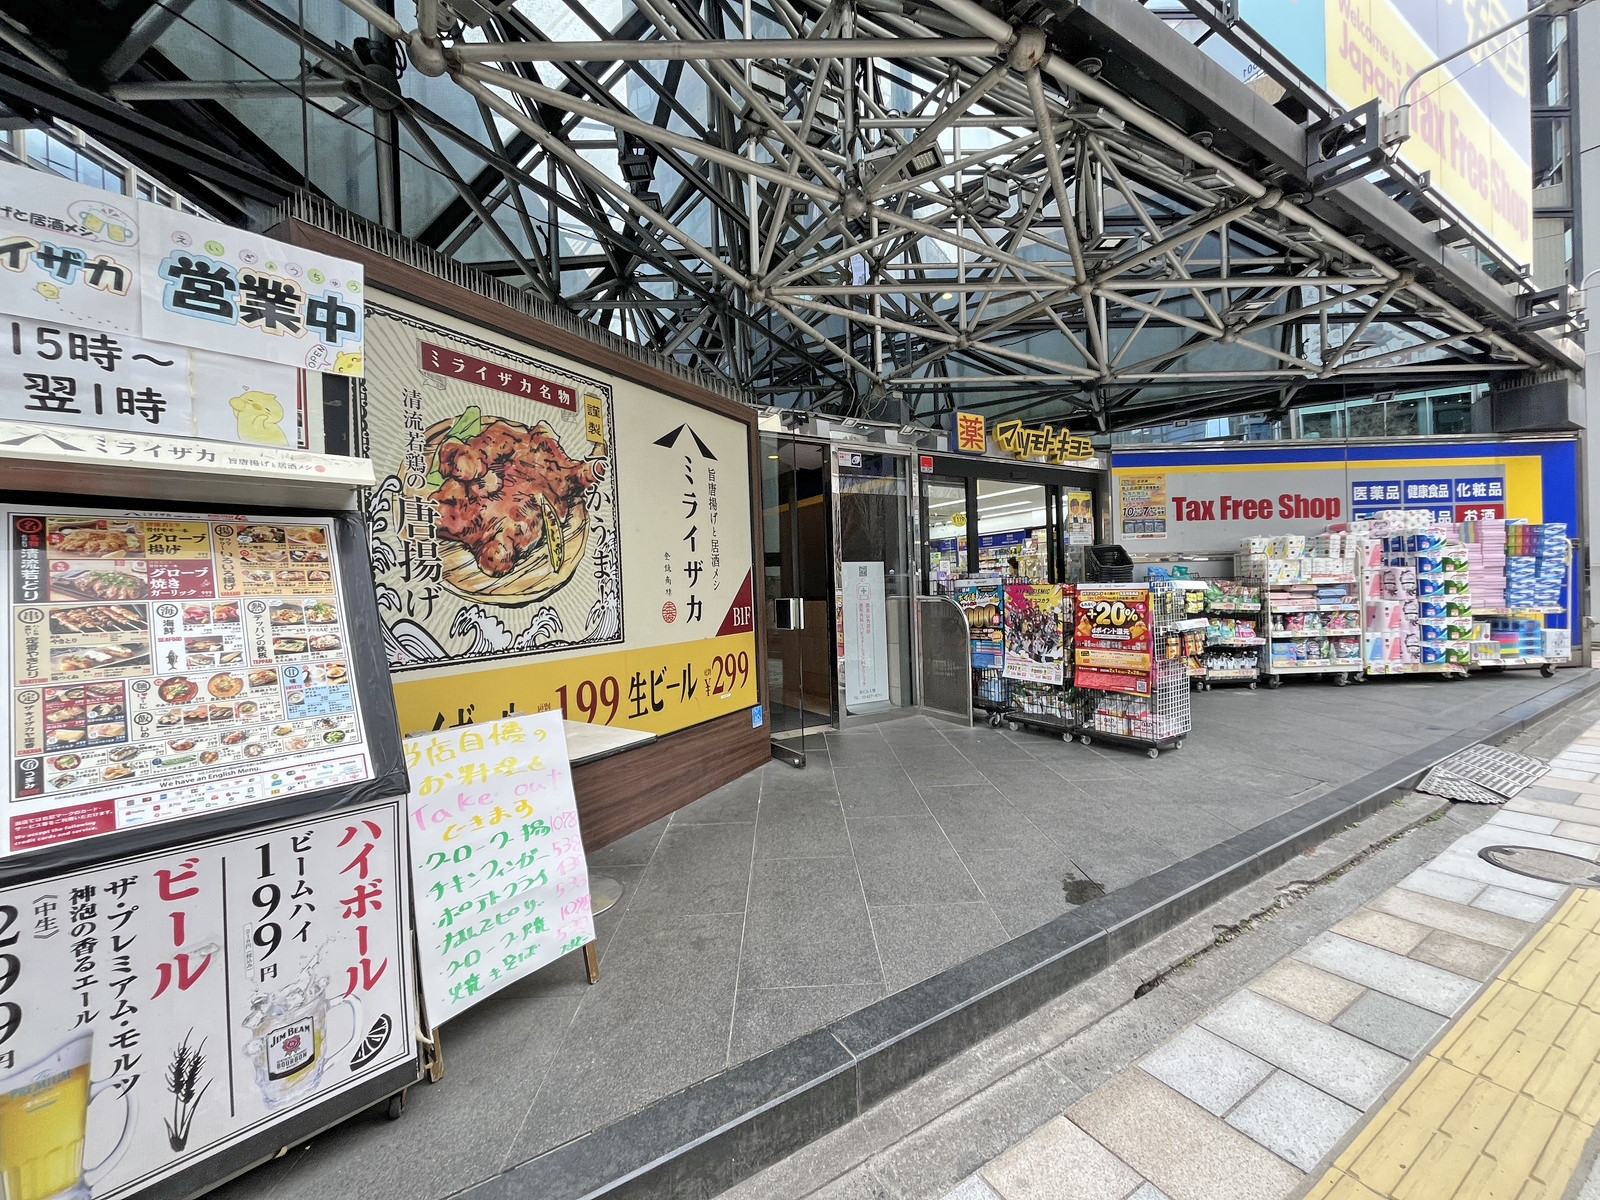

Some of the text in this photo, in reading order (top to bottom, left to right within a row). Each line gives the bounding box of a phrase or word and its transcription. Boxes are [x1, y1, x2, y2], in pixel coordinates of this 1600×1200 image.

[1391, 50, 1402, 75] to
[1405, 62, 1528, 243] Tax Free Shop
[168, 256, 357, 343] 営業中
[308, 345, 324, 370] OPEN
[430, 349, 571, 405] ミライザカ名物
[23, 372, 169, 425] 翌1時
[586, 403, 602, 437] 謹製
[958, 415, 1093, 461] 薬 マツモトキヨシ
[94, 434, 216, 463] ミライザカ
[395, 387, 443, 622] 清流若鶏の唐揚げ
[1172, 496, 1215, 522] Tax
[1220, 495, 1273, 521] Free
[1278, 494, 1341, 521] Shop
[1353, 482, 1502, 501] 医薬品 健康食品 化粧品
[707, 467, 721, 592] 旨唐揚げと居酒メシ
[1464, 508, 1496, 522] お酒
[148, 533, 207, 543] グローブ
[148, 544, 181, 555] 揚げ
[682, 455, 704, 624] ミライザカ
[21, 548, 40, 601] 清流若どり
[150, 567, 209, 578] グローブ
[150, 578, 180, 589] 焼き
[151, 589, 197, 597] ガーリック
[163, 619, 175, 635] 海鮮
[732, 606, 751, 627] B1F
[555, 676, 620, 726] 199
[628, 662, 698, 720] 生ビール
[175, 778, 195, 786] have
[208, 768, 236, 780] English
[237, 766, 261, 774] Menu.
[410, 791, 494, 831] Take
[514, 768, 563, 795] out
[289, 830, 314, 943] ビームハイ
[150, 858, 211, 1000] ビール
[252, 842, 282, 983] 199円
[336, 819, 388, 1000] ハイボール
[69, 884, 100, 1031] 神泡の香るエール
[269, 1024, 311, 1048] JIM BEAM
[276, 1052, 308, 1070] BOURBON
